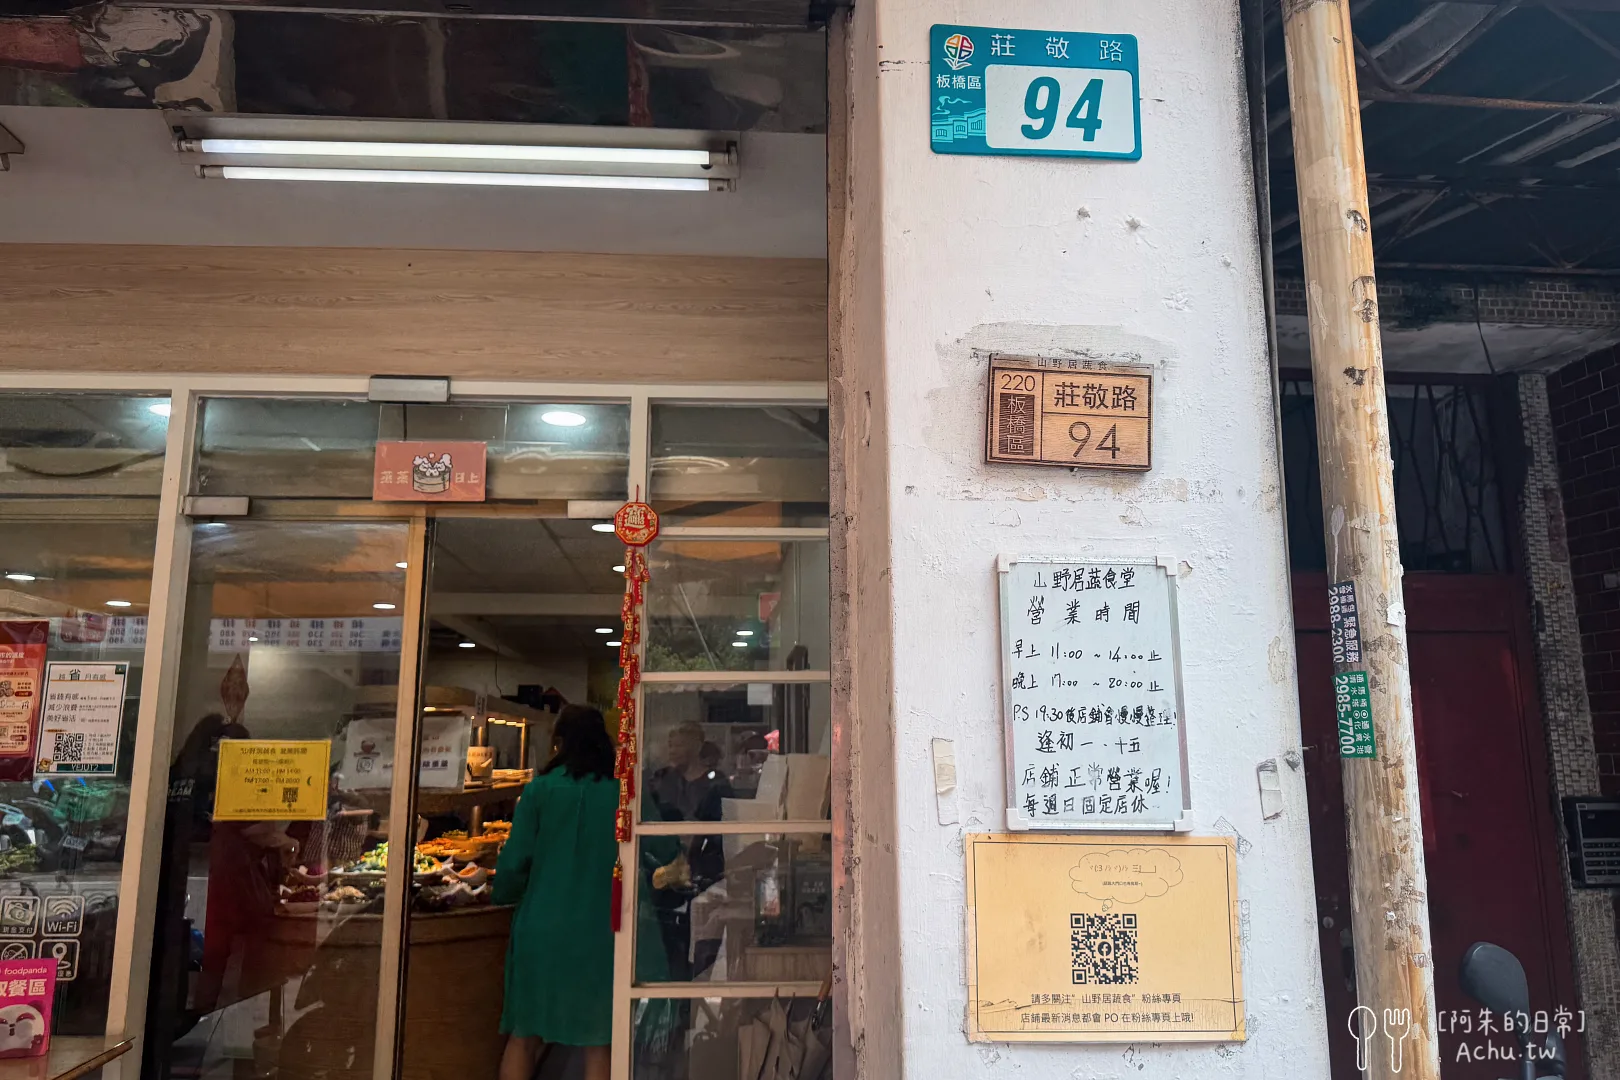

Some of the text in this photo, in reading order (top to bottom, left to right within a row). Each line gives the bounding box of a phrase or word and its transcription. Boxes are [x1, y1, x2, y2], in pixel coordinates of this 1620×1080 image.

[990, 33, 1124, 63] 莊敬路
[935, 73, 983, 91] 板橋區
[1020, 75, 1105, 142] 94
[1037, 357, 1108, 371] 山野居蔬食
[1000, 373, 1036, 392] 220
[1053, 381, 1138, 412] 莊敬路
[1006, 395, 1027, 454] 板橋區
[1067, 420, 1121, 460] 94
[1033, 567, 1136, 592] 山野居蔬食堂
[1026, 595, 1141, 625] 營業時間
[1327, 586, 1345, 664] 2988-2300
[1011, 638, 1041, 659] 早上
[1050, 642, 1083, 660] 11:00
[1011, 671, 1040, 690] 晚上
[1108, 677, 1143, 689] 20:00
[1334, 675, 1356, 755] 2985-7700
[47, 921, 77, 932] Wi-Fi
[4, 966, 48, 976] foodpanda
[1141, 993, 1182, 1005] 粉絲專頁
[1104, 1013, 1119, 1023] PO
